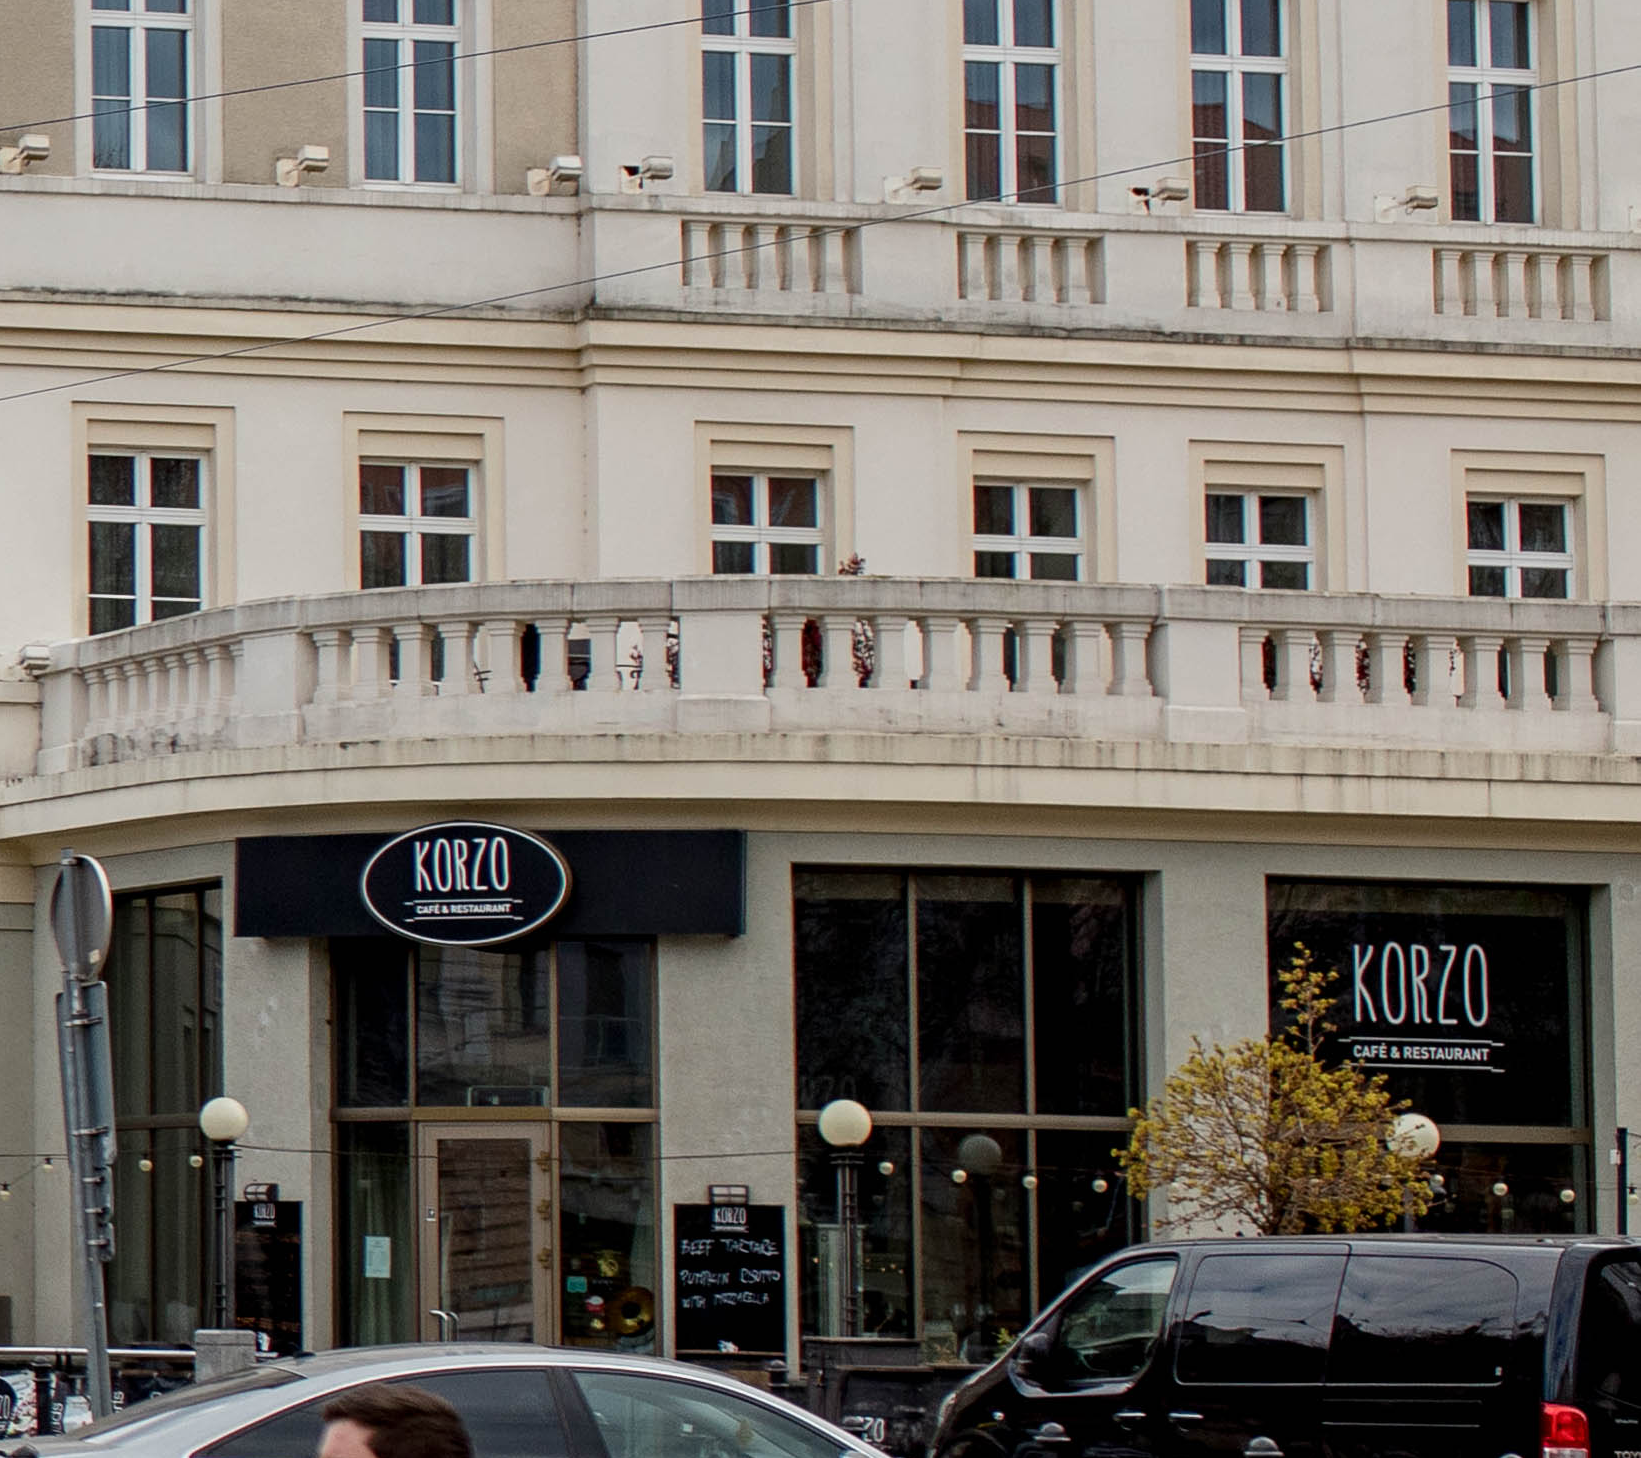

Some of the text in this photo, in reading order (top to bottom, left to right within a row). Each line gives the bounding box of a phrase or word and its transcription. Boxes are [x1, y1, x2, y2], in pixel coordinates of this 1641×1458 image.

[414, 837, 510, 892] KORZO
[416, 903, 511, 914] CAFÉ & RESTAURANT
[1352, 942, 1489, 1027] KORZO
[1353, 1042, 1490, 1061] CAFÉ & RESTAURANT
[714, 1207, 747, 1224] KORZO
